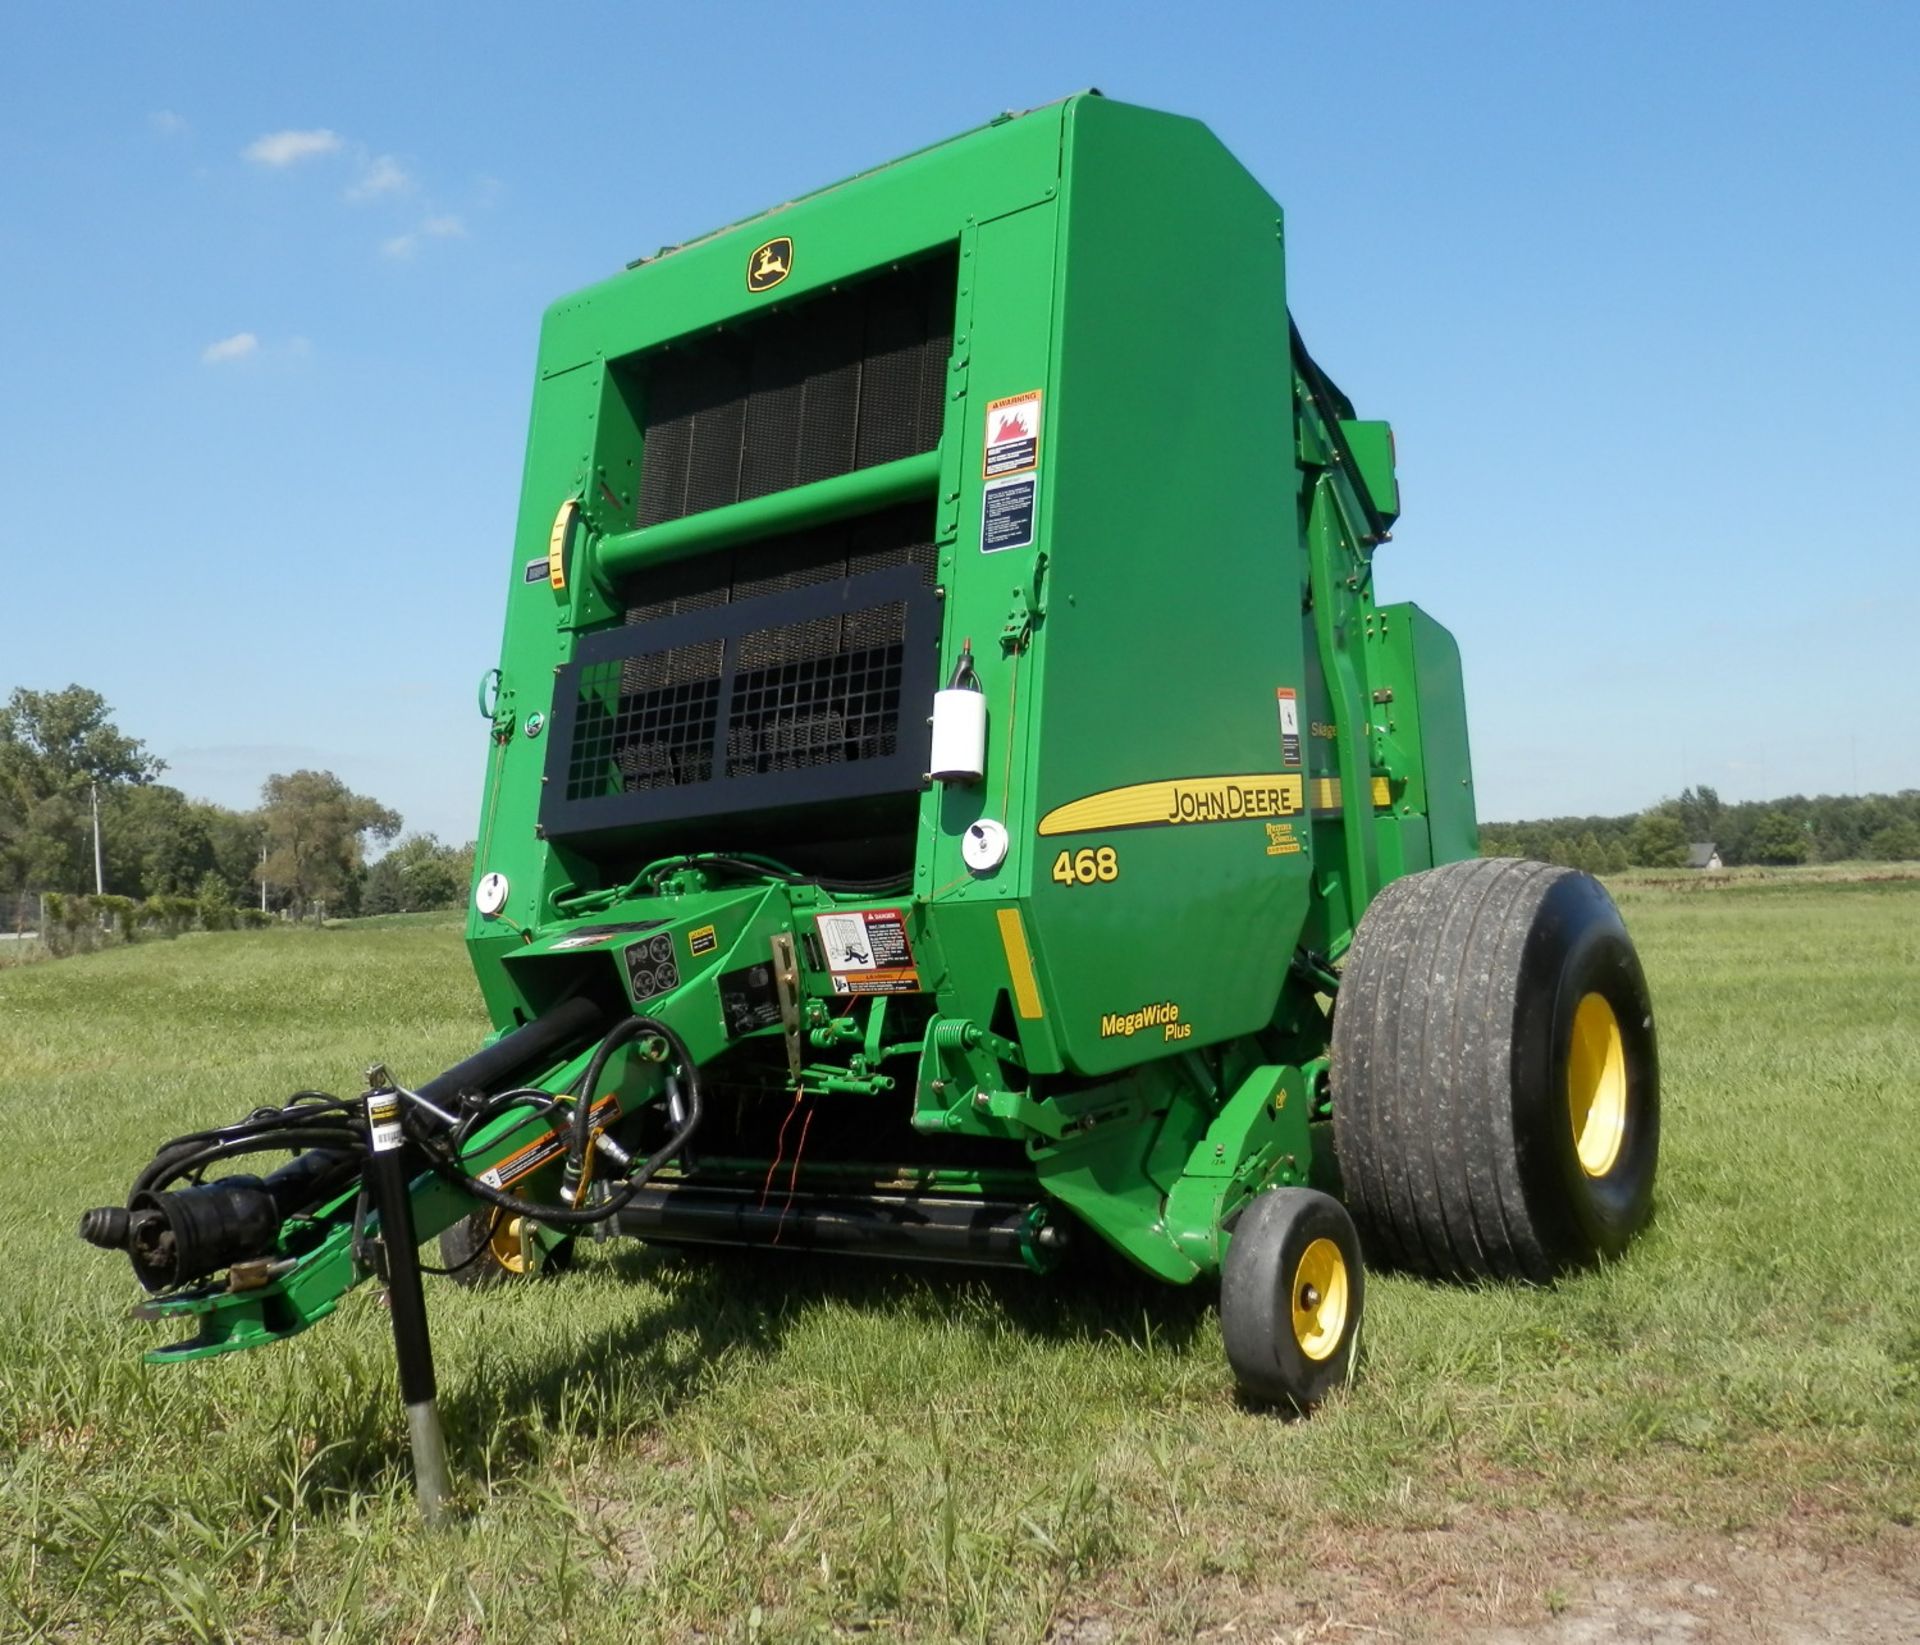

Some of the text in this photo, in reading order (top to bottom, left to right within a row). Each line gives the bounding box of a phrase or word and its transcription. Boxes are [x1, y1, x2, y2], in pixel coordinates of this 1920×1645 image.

[1168, 785, 1292, 820] JOHN DEERE
[1053, 846, 1119, 886] 468
[1101, 1002, 1179, 1037] MegaWide
[1165, 1022, 1191, 1042] Plus
